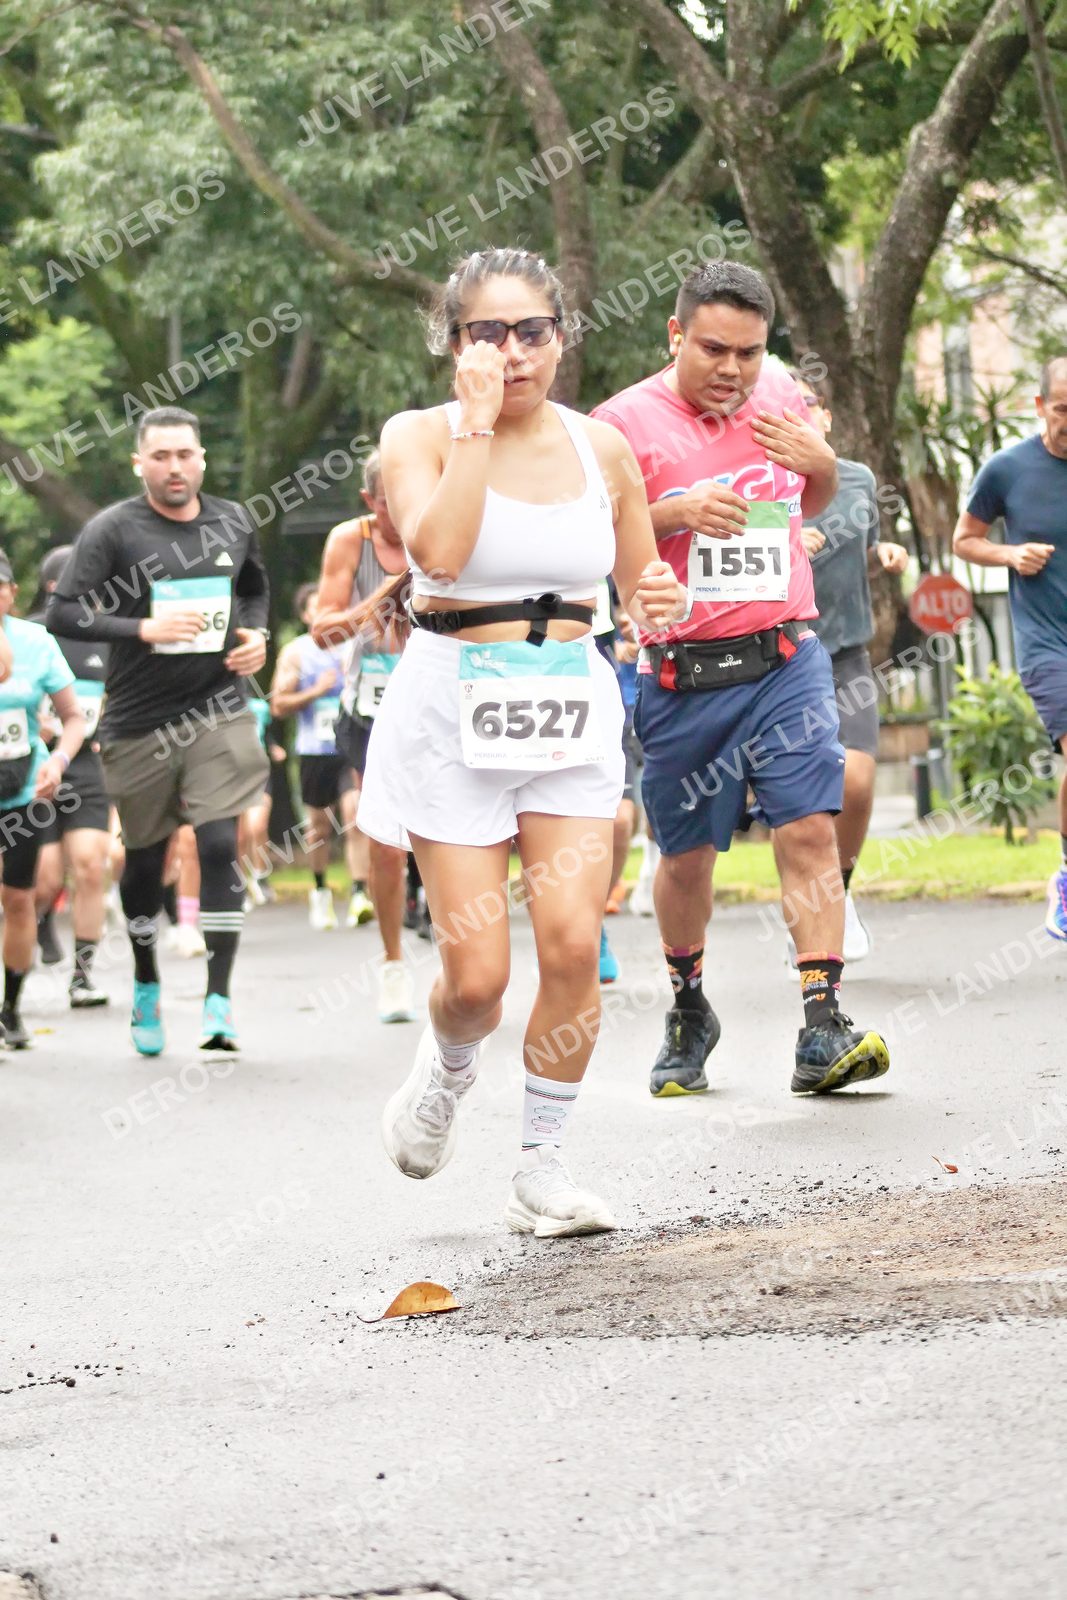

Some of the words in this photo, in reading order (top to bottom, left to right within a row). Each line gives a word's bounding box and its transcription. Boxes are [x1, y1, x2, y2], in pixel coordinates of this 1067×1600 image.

[698, 547, 781, 577] 1551
[918, 588, 969, 618] ALTO
[472, 699, 590, 741] 6527
